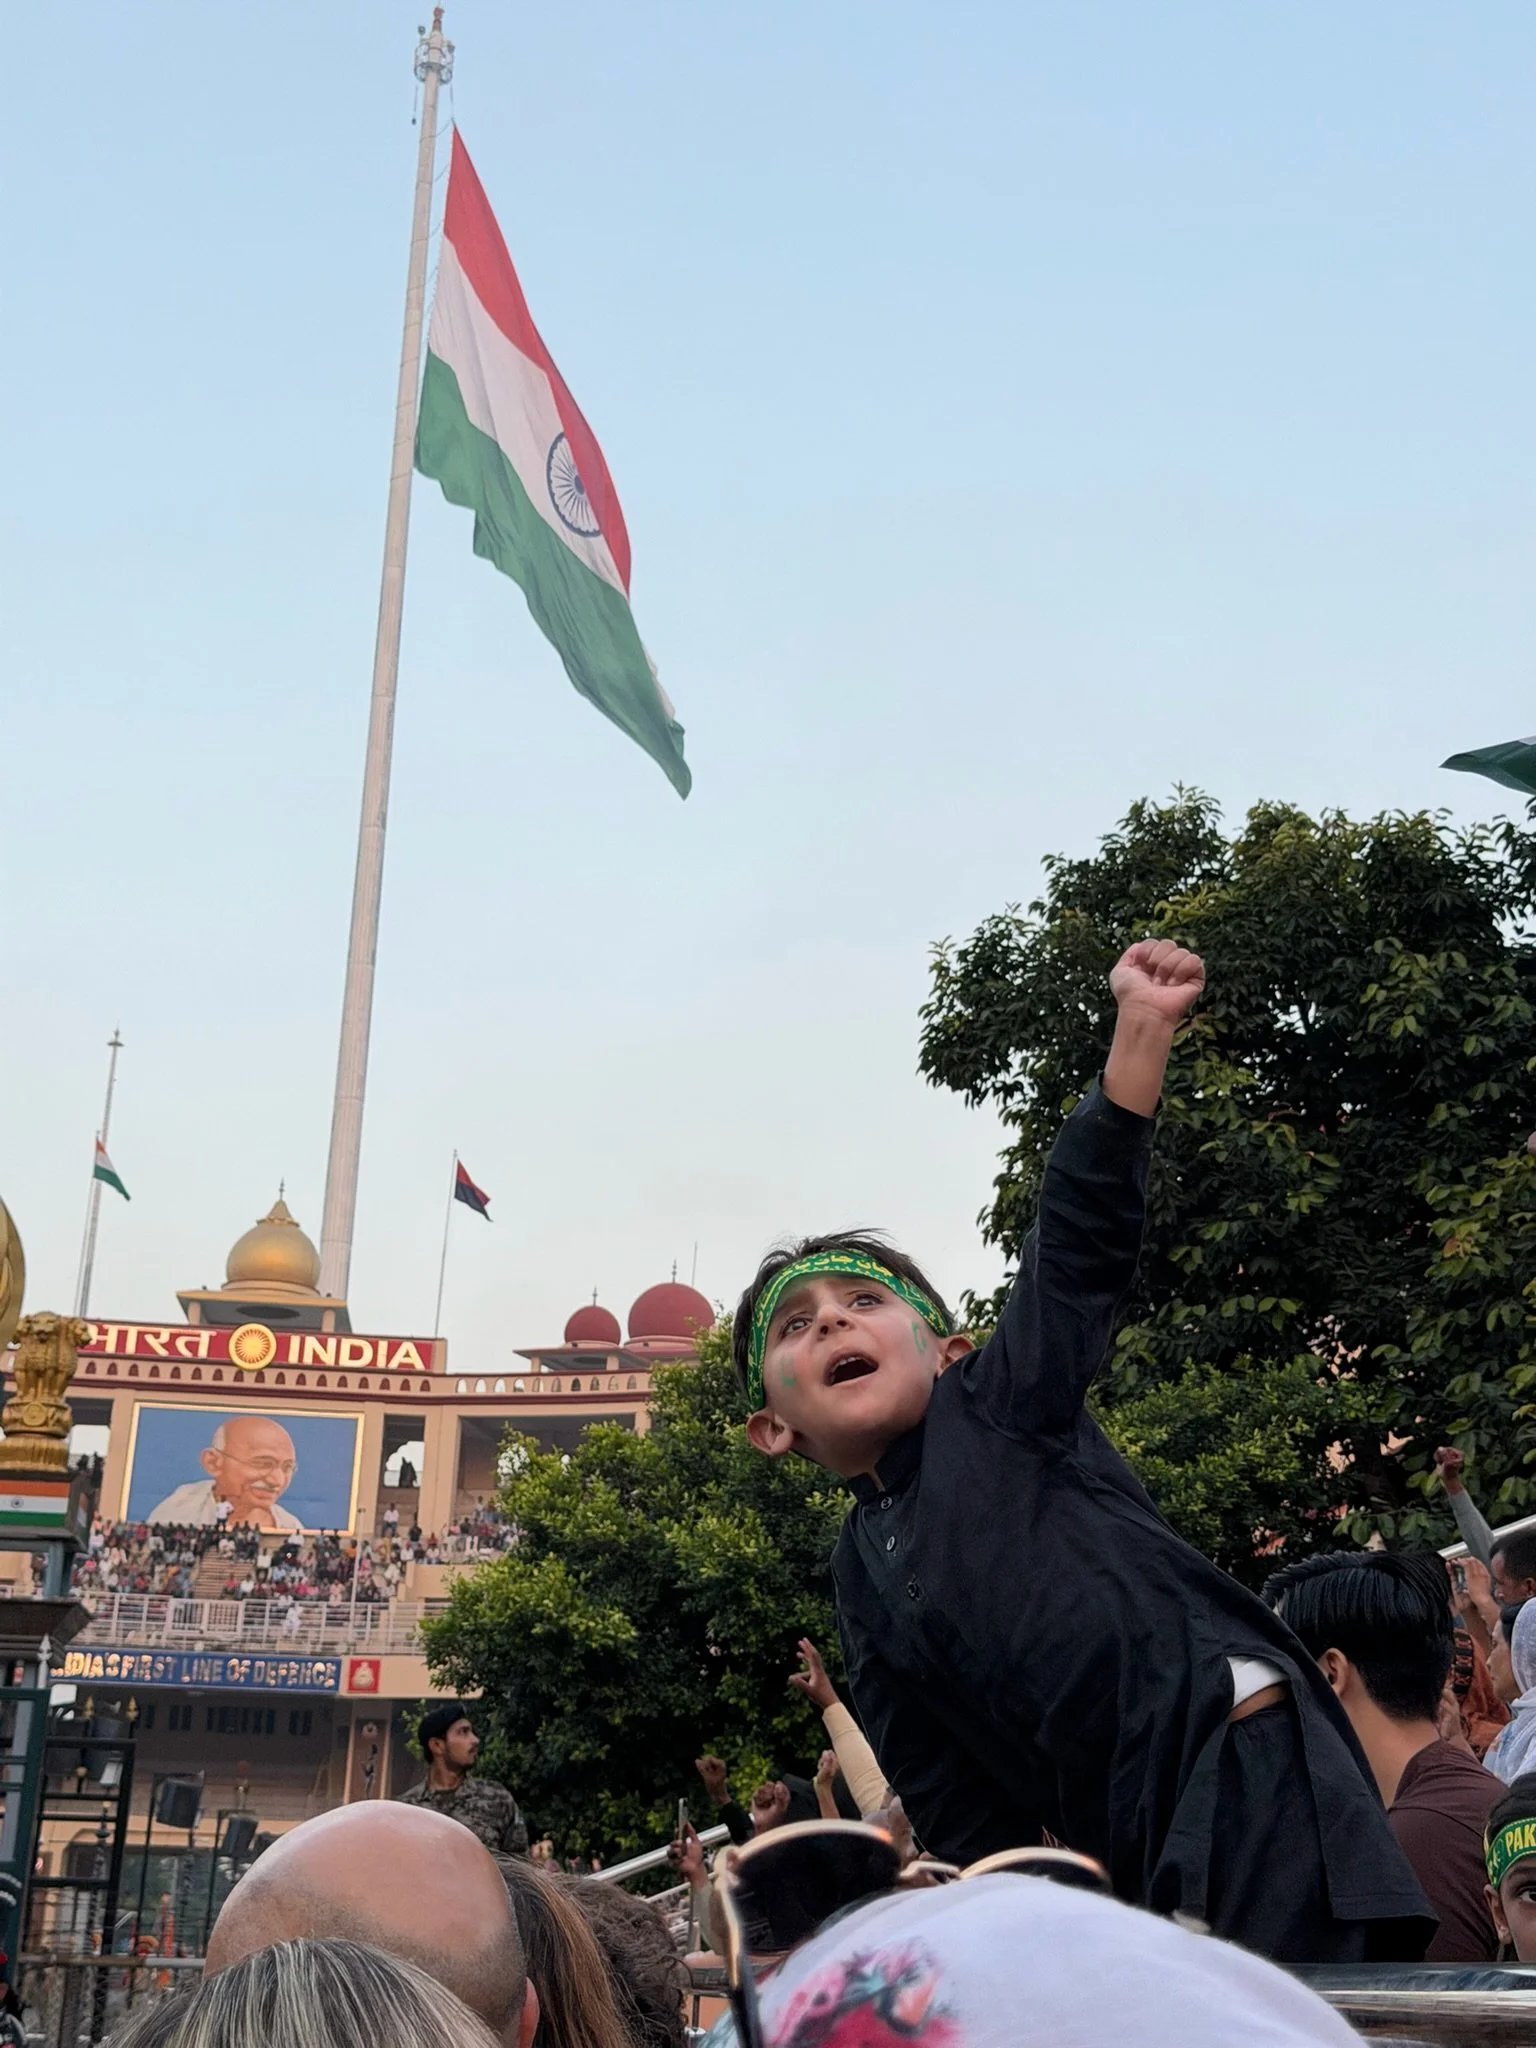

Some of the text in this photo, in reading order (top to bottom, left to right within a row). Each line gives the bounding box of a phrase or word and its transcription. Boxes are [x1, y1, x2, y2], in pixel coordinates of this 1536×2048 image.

[86, 1322, 217, 1359] भारत
[288, 1335, 425, 1370] INDIA
[50, 1651, 337, 1688] DIA'S FIRST LINE OF DEFENCE
